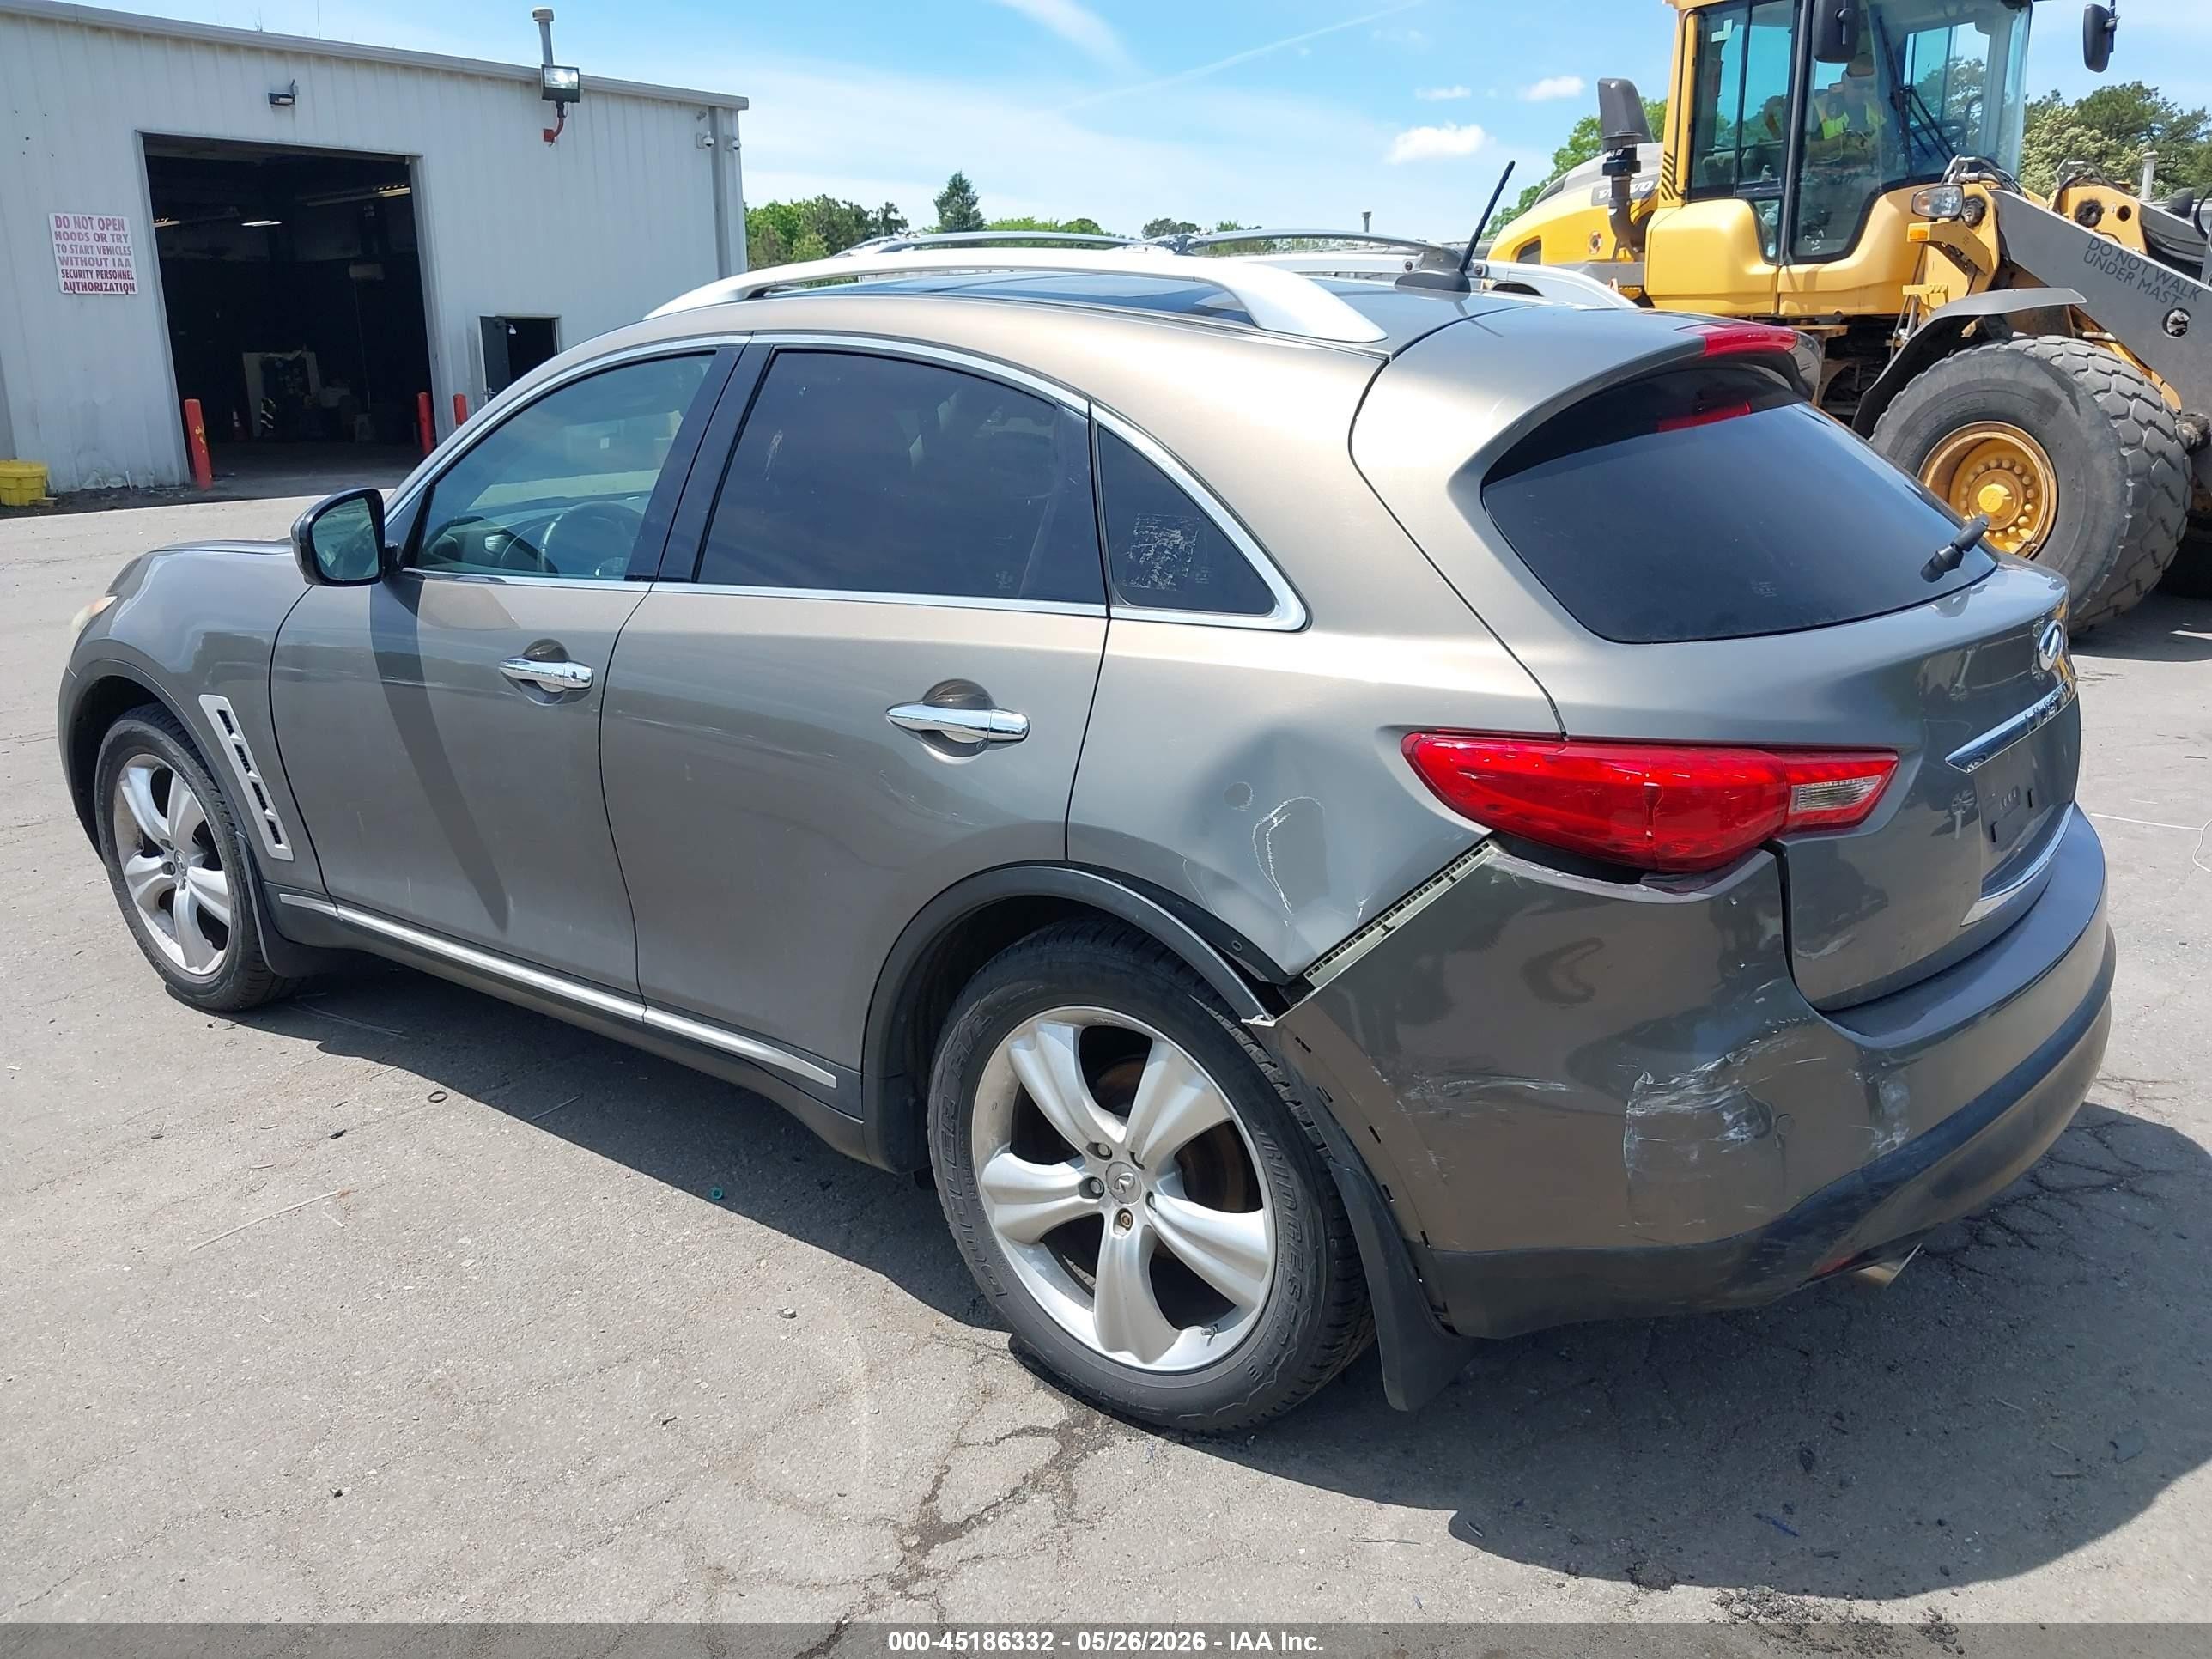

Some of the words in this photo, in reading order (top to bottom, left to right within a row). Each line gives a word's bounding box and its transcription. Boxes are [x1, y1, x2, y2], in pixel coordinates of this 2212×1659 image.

[1598, 180, 1654, 199] VVO
[54, 215, 70, 229] DO
[73, 216, 94, 230] NOT
[97, 216, 125, 232] OPEN
[54, 230, 90, 242] HOODS
[93, 232, 108, 243] OR
[110, 233, 129, 244] TRY
[55, 243, 68, 254] TO
[69, 244, 94, 255] START
[96, 245, 131, 257] VEHICLES
[58, 256, 109, 267] WITHOUT
[112, 257, 131, 268] IAA
[61, 268, 94, 280] SECURITY
[95, 270, 134, 281] PERSONNEL
[2087, 237, 2112, 257] DO
[2115, 251, 2154, 276] NOT
[2155, 268, 2203, 302] WALK
[2083, 249, 2135, 286] UNDER
[2136, 277, 2182, 307] MAST
[63, 281, 136, 293] AUTHORIZATION
